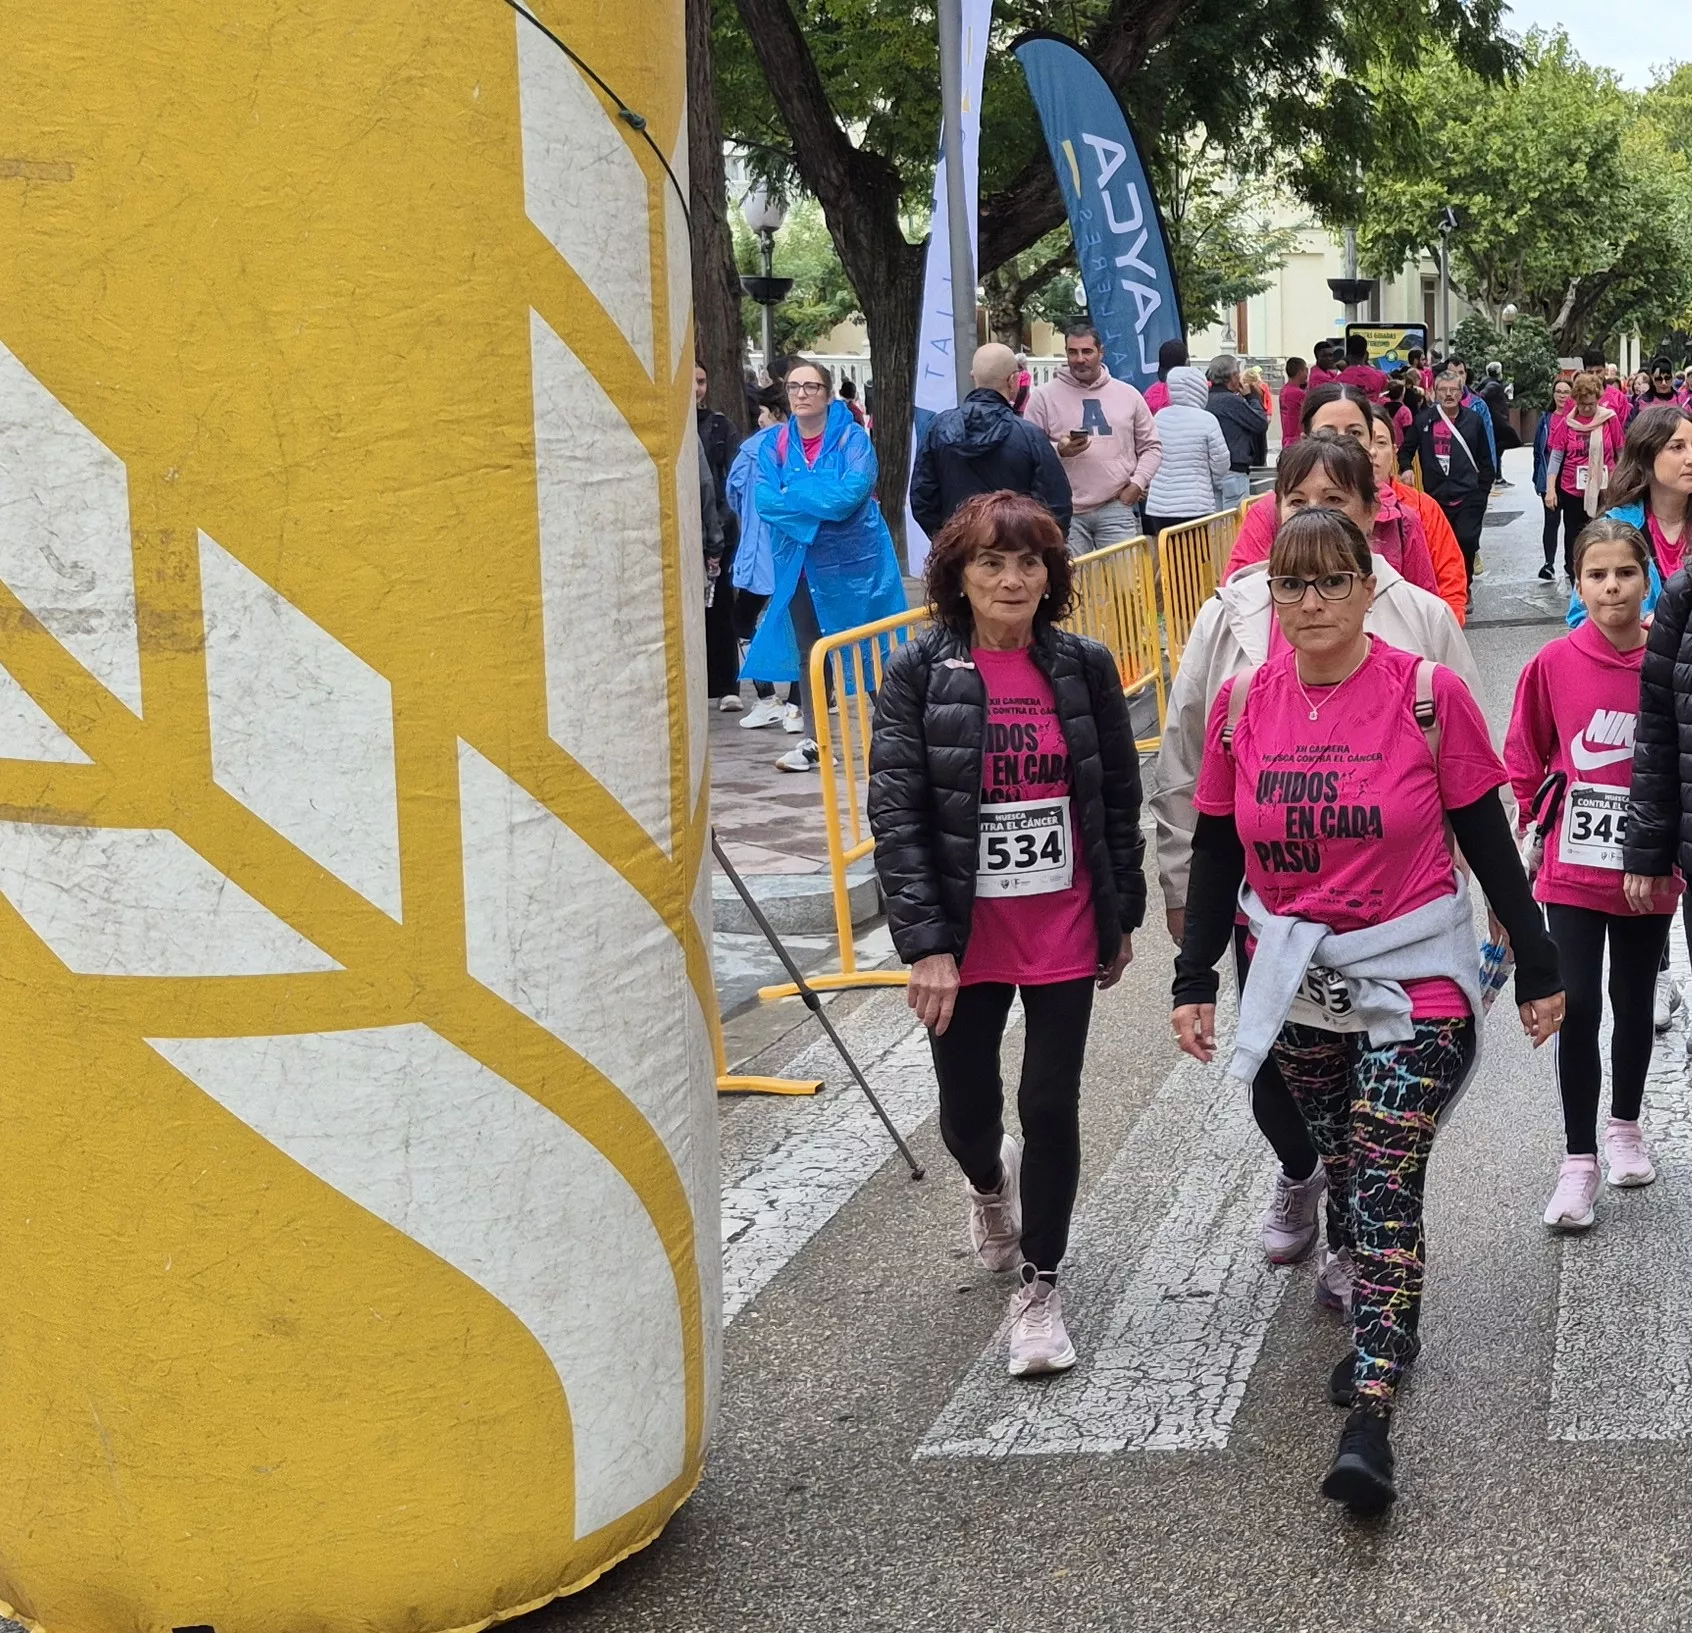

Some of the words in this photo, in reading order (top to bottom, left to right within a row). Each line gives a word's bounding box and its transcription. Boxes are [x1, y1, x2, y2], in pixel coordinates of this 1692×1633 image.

[1081, 399, 1112, 436] A
[985, 723, 1039, 753] IDOS
[1585, 708, 1637, 749] NIK
[993, 754, 1019, 786] EN
[1347, 752, 1383, 763] CÁNCER
[1256, 769, 1340, 805] UNIDOS
[1577, 798, 1611, 809] CONTRA
[1612, 801, 1623, 810] EL
[995, 812, 1027, 821] HUESCA
[1006, 820, 1020, 831] EL
[1020, 815, 1059, 828] CÁNCER
[1286, 805, 1316, 840] EN
[1320, 805, 1384, 841] CADA
[976, 831, 1063, 871] 534
[1253, 839, 1321, 874] PASO
[1298, 974, 1352, 1014] 53
